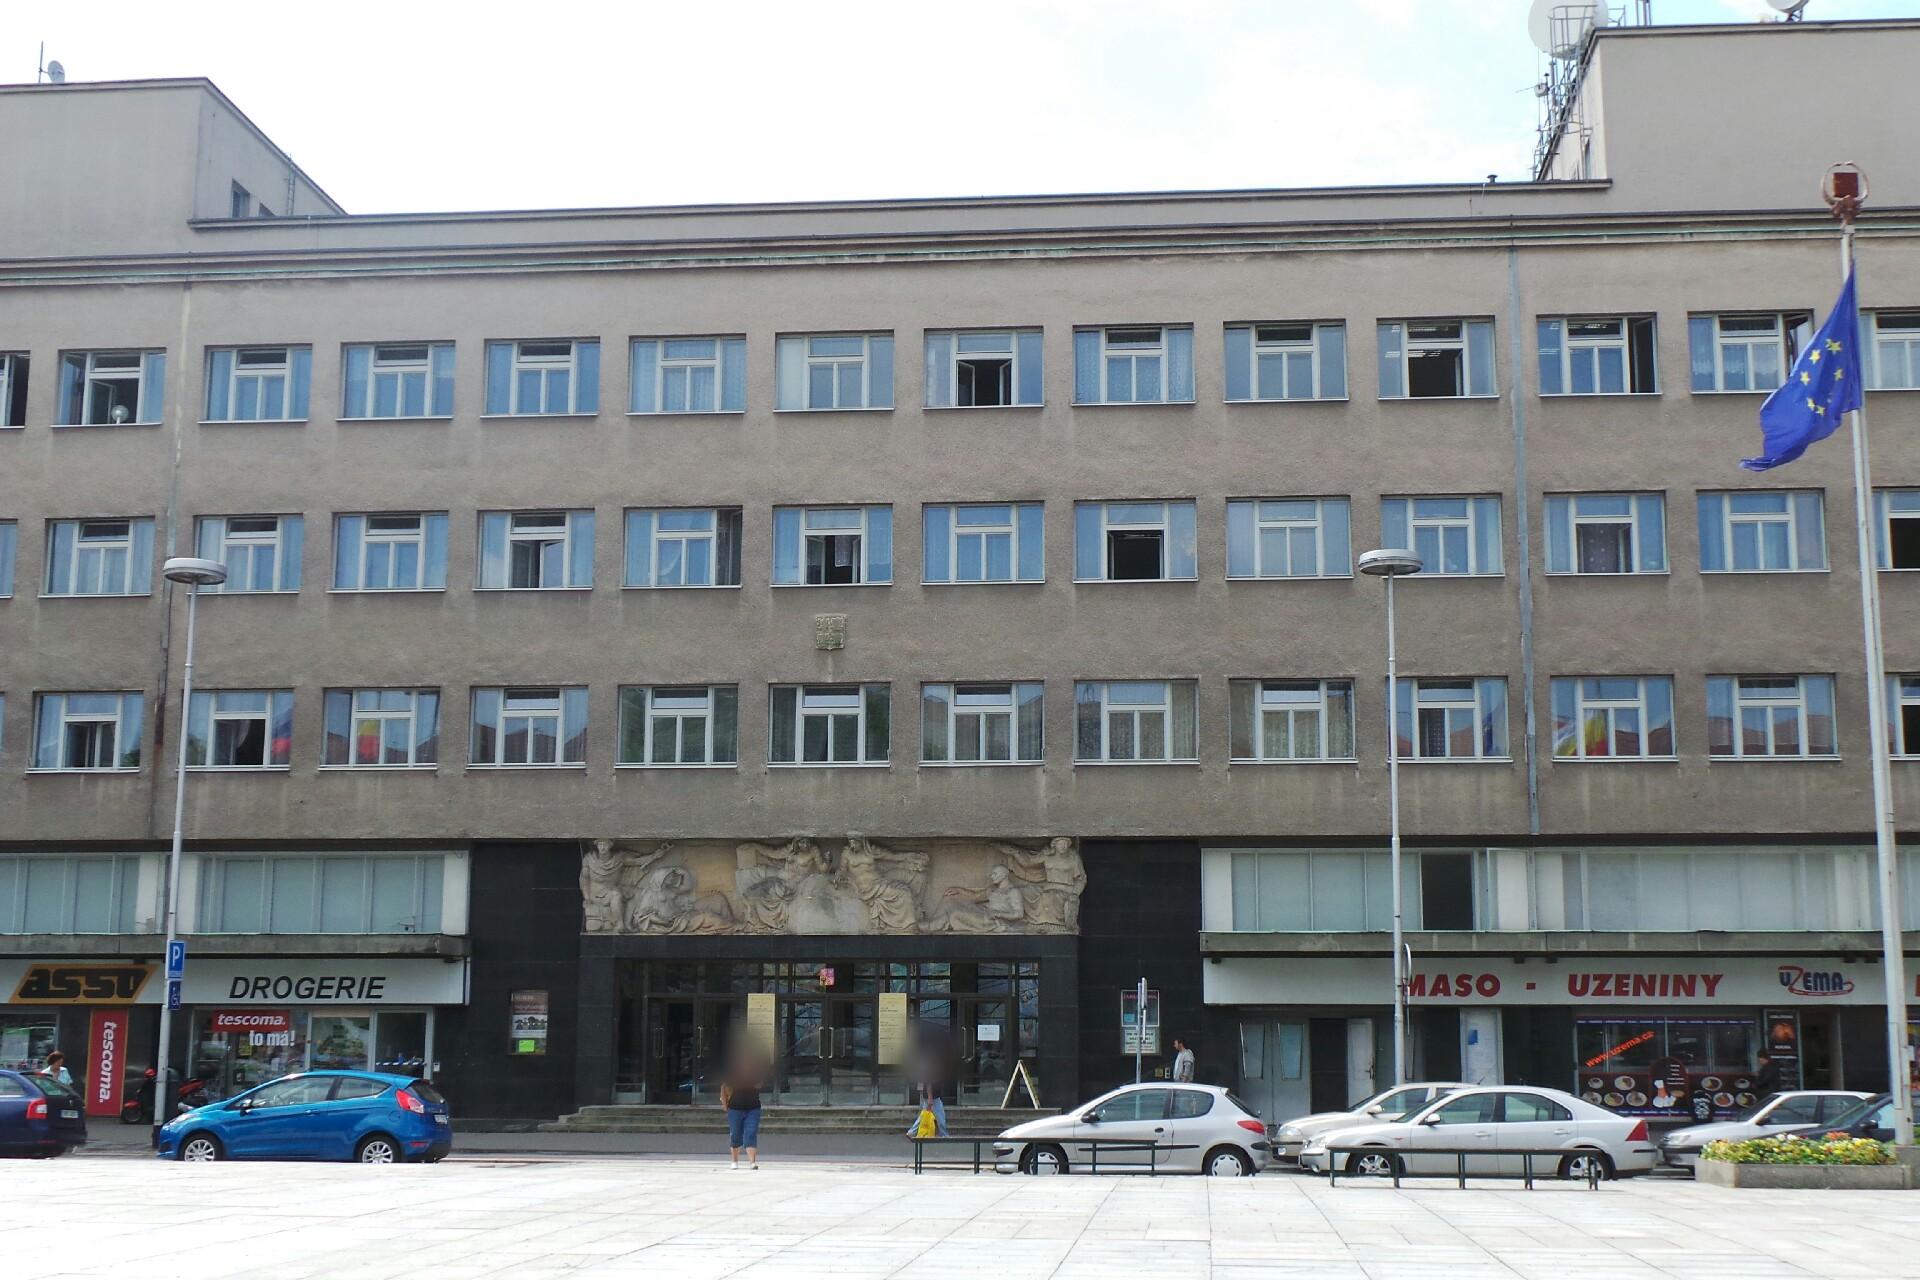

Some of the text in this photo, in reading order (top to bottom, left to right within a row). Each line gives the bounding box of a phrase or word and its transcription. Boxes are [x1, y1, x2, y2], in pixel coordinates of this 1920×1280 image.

[172, 945, 180, 967] P
[229, 975, 386, 999] DROGERIE
[1402, 973, 1501, 997] MASO
[1567, 973, 1723, 998] UZENINY
[249, 1029, 295, 1047] to má!
